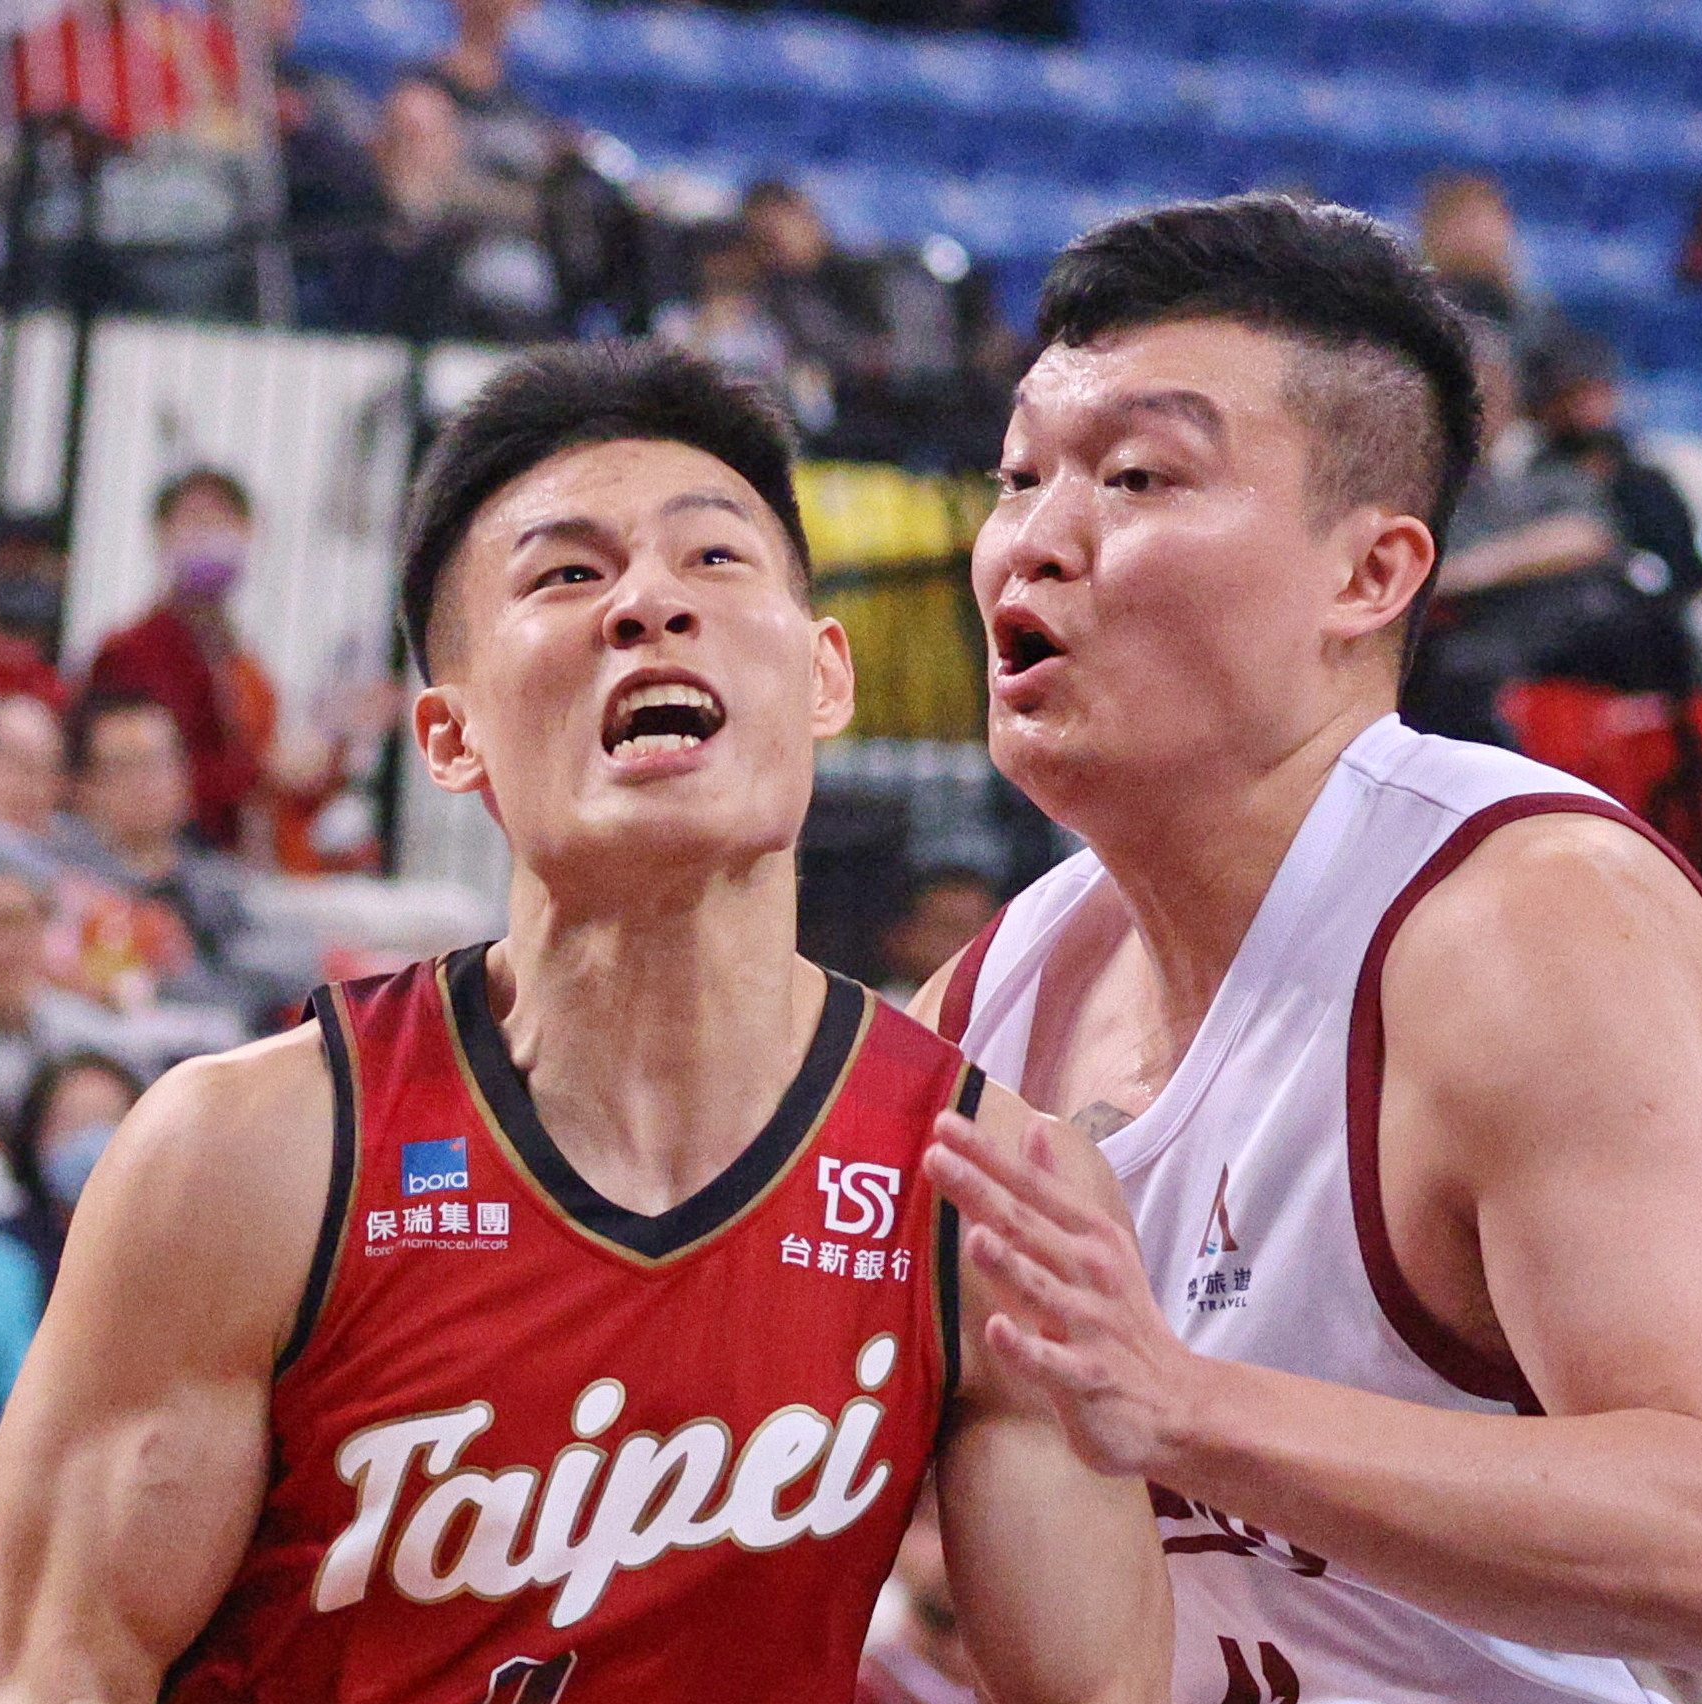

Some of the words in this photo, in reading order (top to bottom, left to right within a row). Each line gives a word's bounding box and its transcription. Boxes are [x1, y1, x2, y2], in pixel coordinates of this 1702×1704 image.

[408, 1171, 469, 1194] bora
[366, 1201, 510, 1242] 保瑞集團
[781, 1232, 912, 1283] 台新銀行
[1198, 1297, 1247, 1313] TRAVEL
[312, 1332, 897, 1628] Taipei
